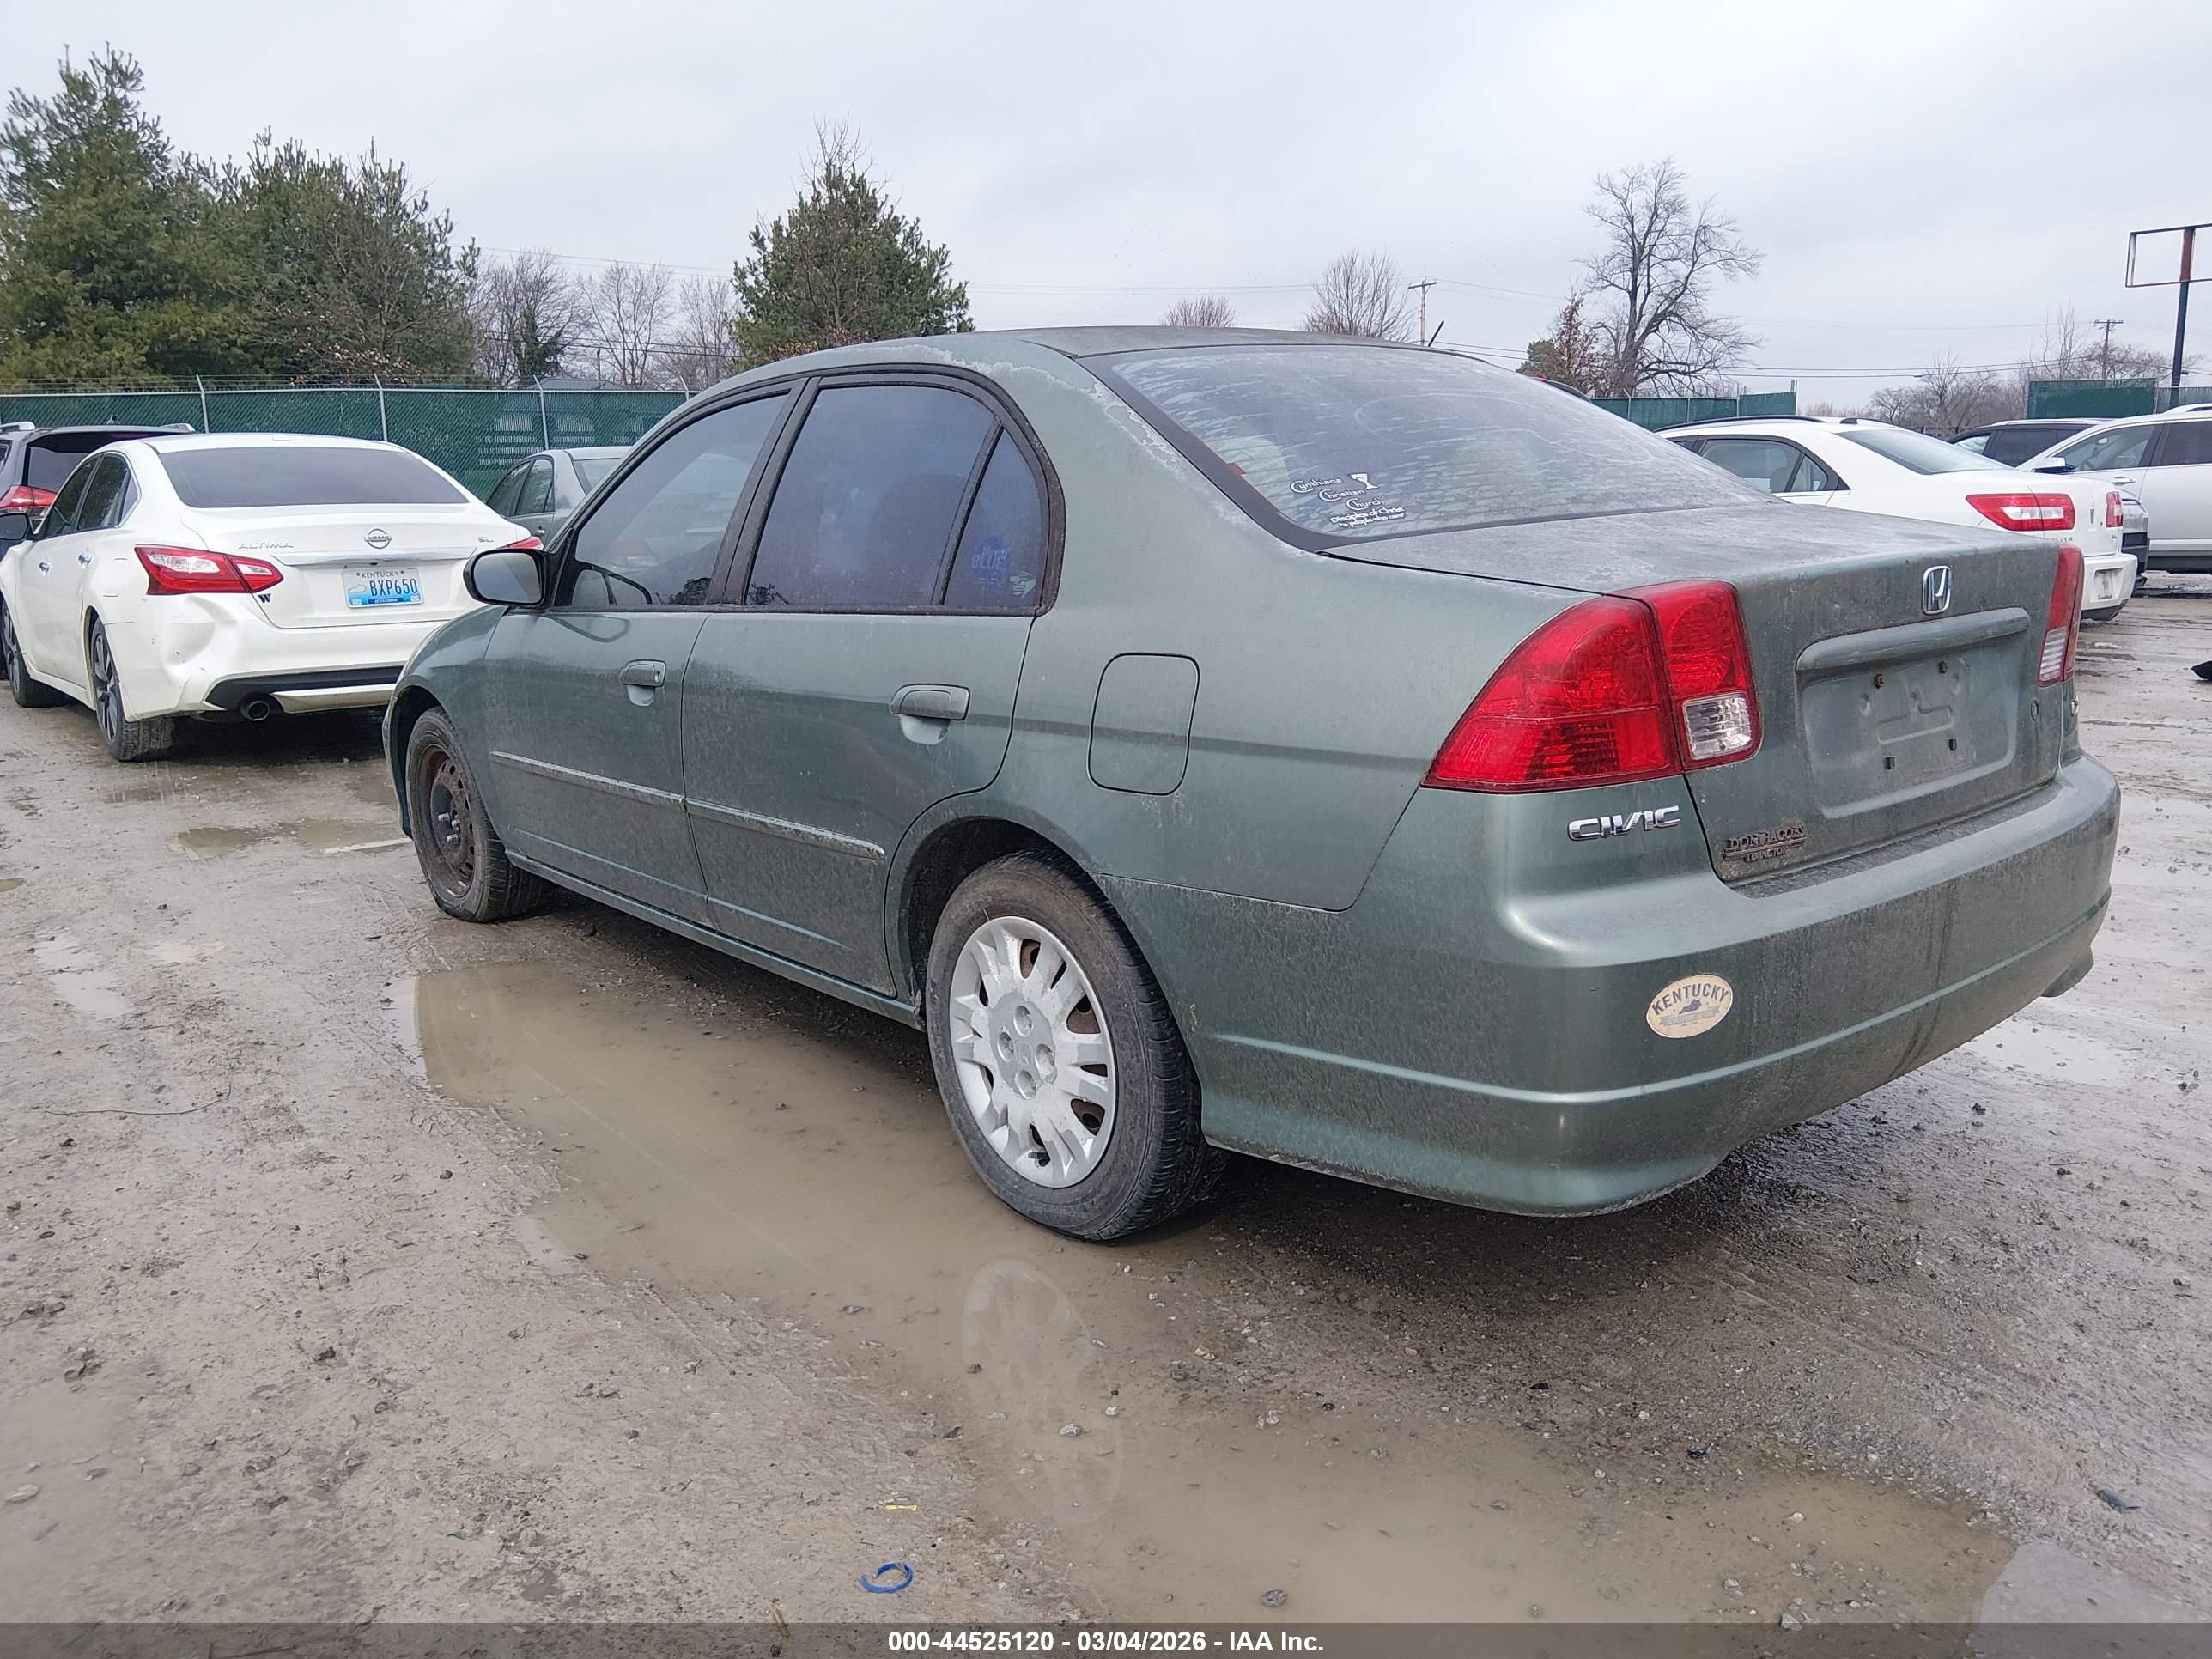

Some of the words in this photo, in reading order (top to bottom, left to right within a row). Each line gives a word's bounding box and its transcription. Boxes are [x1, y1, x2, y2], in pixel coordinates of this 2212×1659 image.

[1291, 477, 1343, 493] Cynthiana
[1318, 489, 1365, 501] Christian
[1346, 497, 1384, 511] Church
[1330, 512, 1369, 523] Disciples
[369, 578, 418, 597] BXP650
[1568, 805, 1680, 842] CIVIC
[1651, 983, 1729, 1015] KENTUCKY
